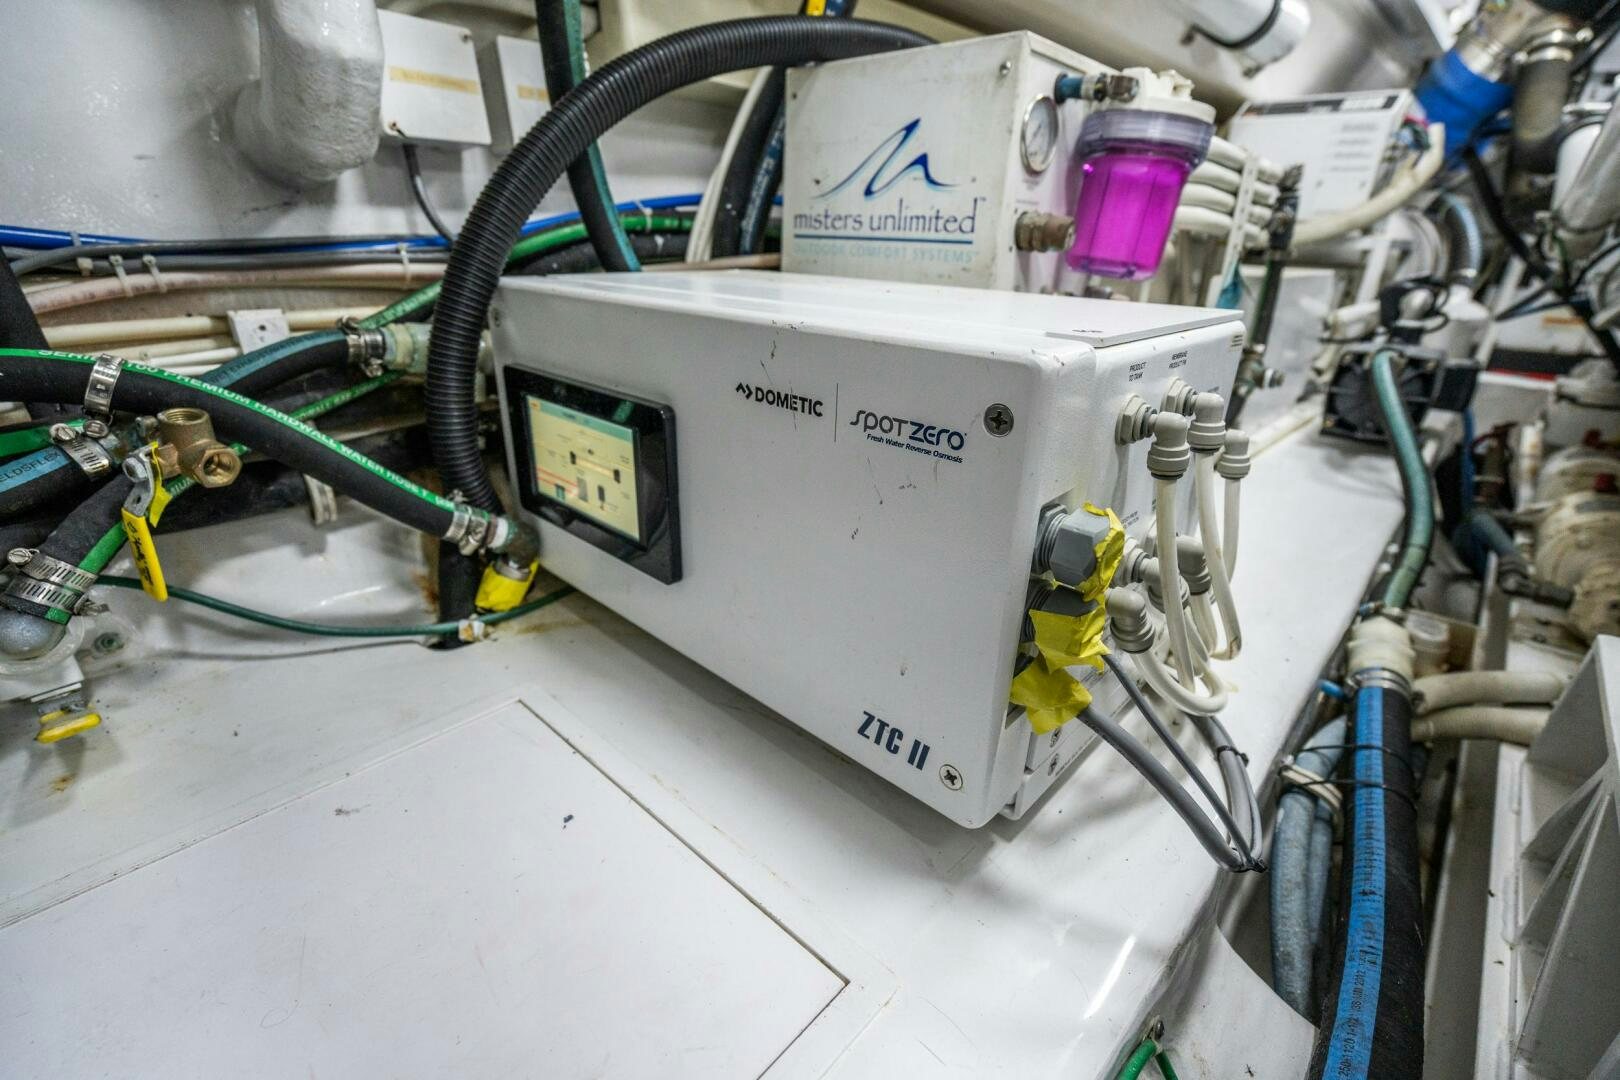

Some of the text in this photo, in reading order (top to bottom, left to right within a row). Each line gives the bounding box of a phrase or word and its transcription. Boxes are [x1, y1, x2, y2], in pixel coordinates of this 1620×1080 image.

[793, 197, 977, 234] misters unlimited
[912, 247, 973, 264] SYSTEMS
[755, 386, 823, 418] DOMETIC
[340, 443, 384, 474] WATER
[866, 433, 963, 464] Fresh Water Reverse Osmosis
[857, 710, 931, 771] ZTC II
